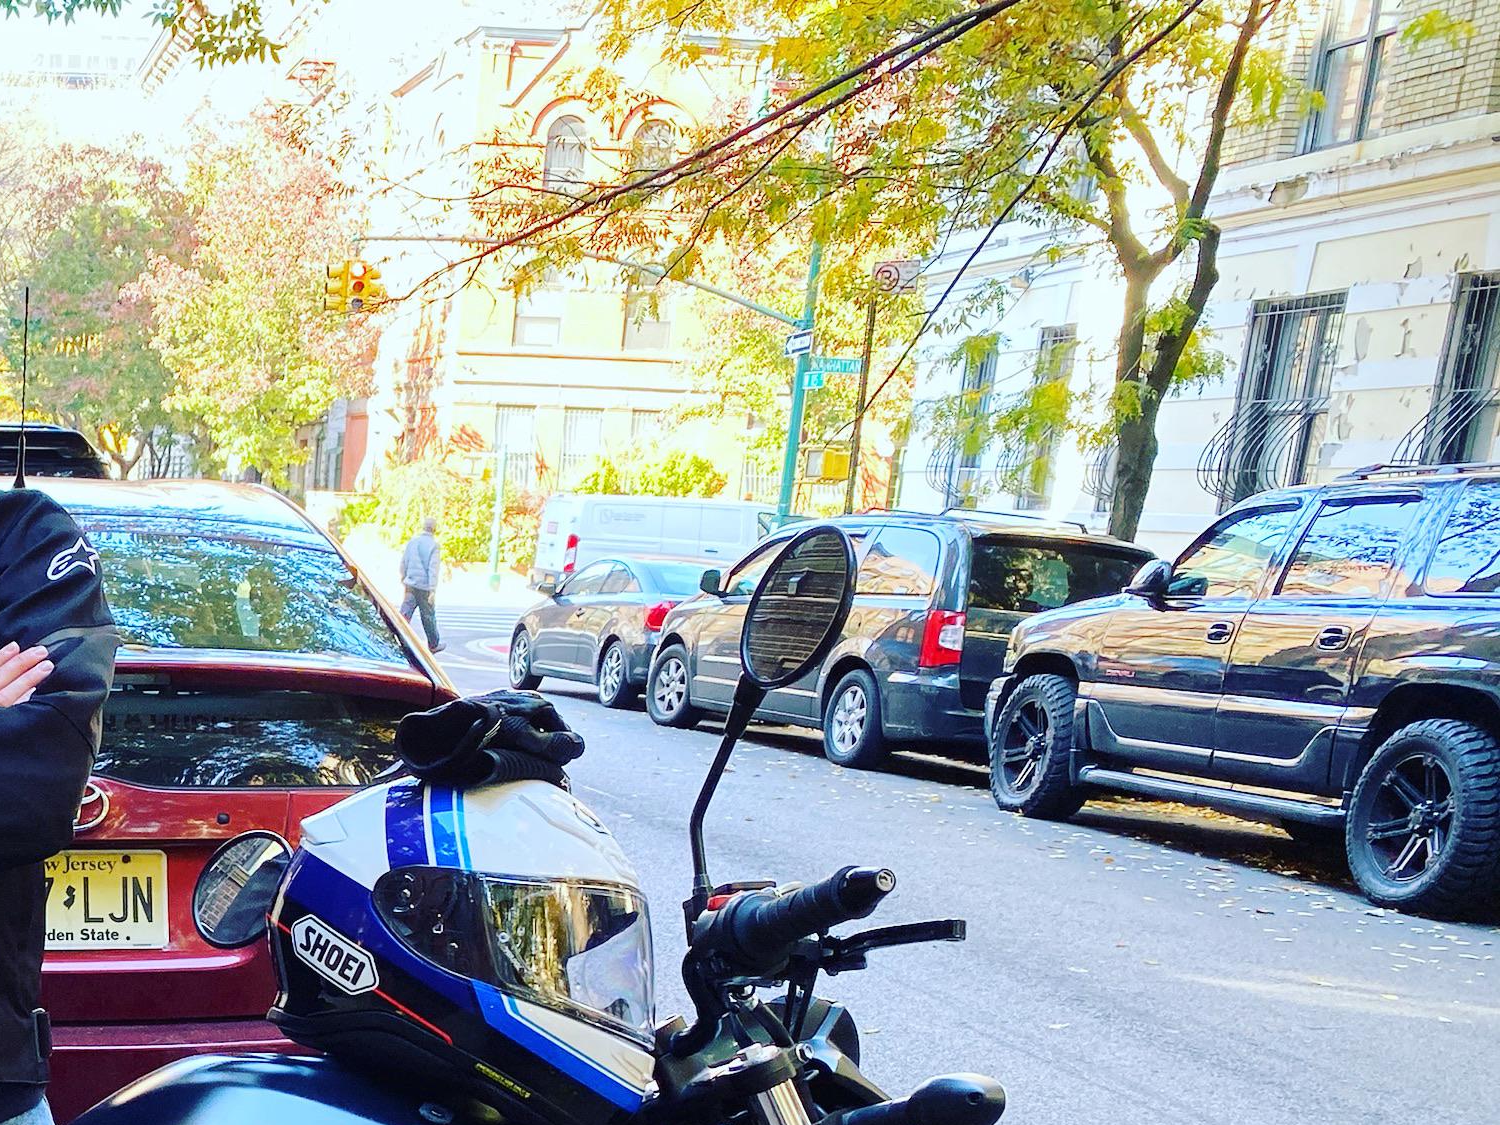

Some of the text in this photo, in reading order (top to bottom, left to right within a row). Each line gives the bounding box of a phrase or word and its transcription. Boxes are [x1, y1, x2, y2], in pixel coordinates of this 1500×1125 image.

[62, 855, 117, 874] Jersey
[83, 876, 153, 923] LJN
[80, 928, 119, 941] State
[299, 925, 366, 986] SHOEI
